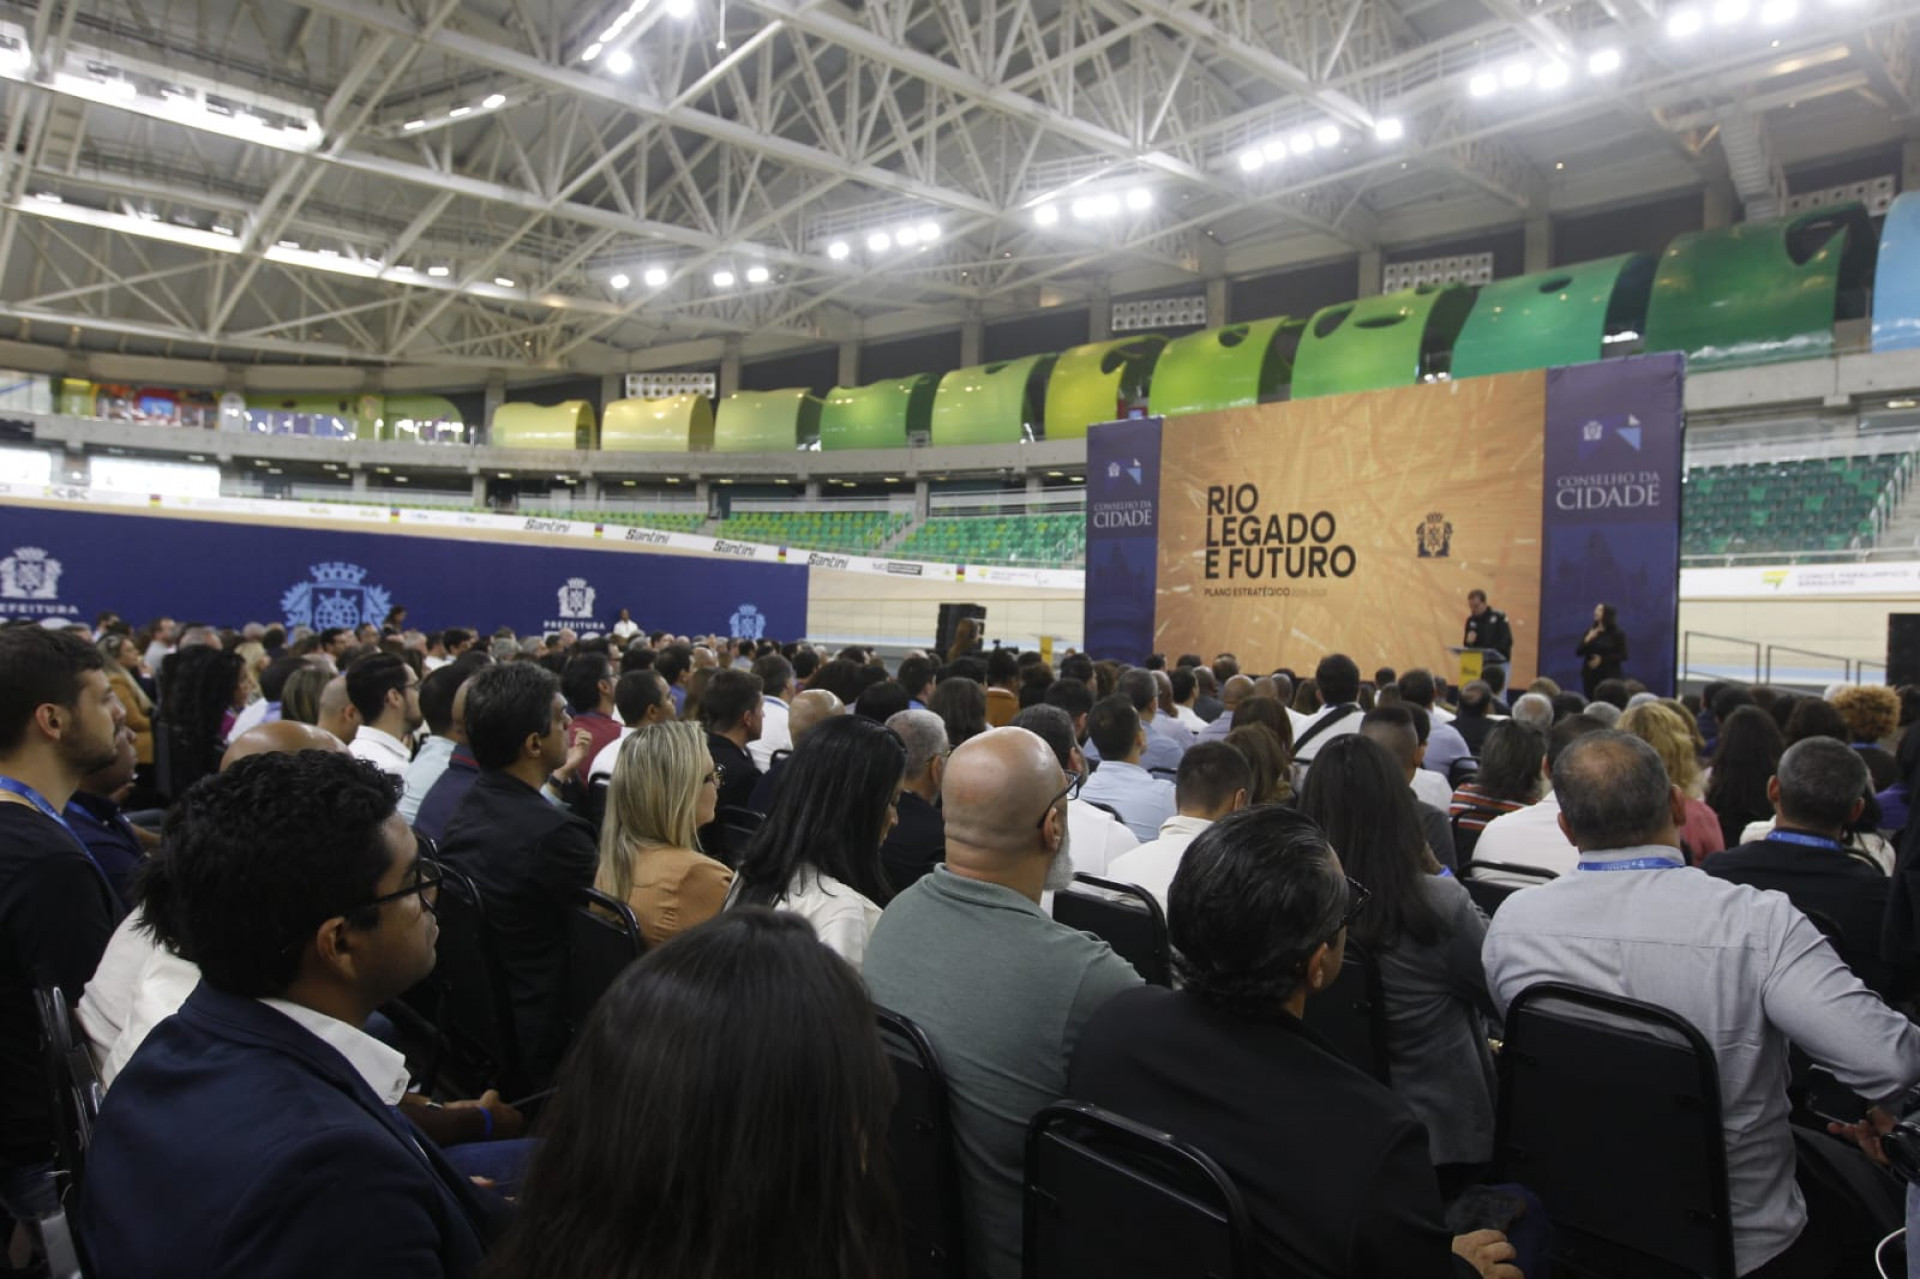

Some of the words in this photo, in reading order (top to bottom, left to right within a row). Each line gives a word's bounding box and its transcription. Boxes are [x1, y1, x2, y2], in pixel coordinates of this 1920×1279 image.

[1557, 472, 1635, 488] CONSELHO
[1639, 471, 1660, 484] DA
[1207, 482, 1259, 516] RIO
[1556, 484, 1661, 511] CIDADE
[524, 518, 572, 533] Santini
[1093, 508, 1153, 529] CIDADE
[625, 528, 671, 545] Santini
[1206, 511, 1336, 547] LEGADO
[713, 540, 757, 557] Santini
[807, 552, 849, 570] Santini
[1205, 549, 1220, 579] E
[1228, 545, 1357, 579] FUTURO
[1204, 587, 1232, 597] PLANO
[543, 620, 606, 630] PREFEITURA
